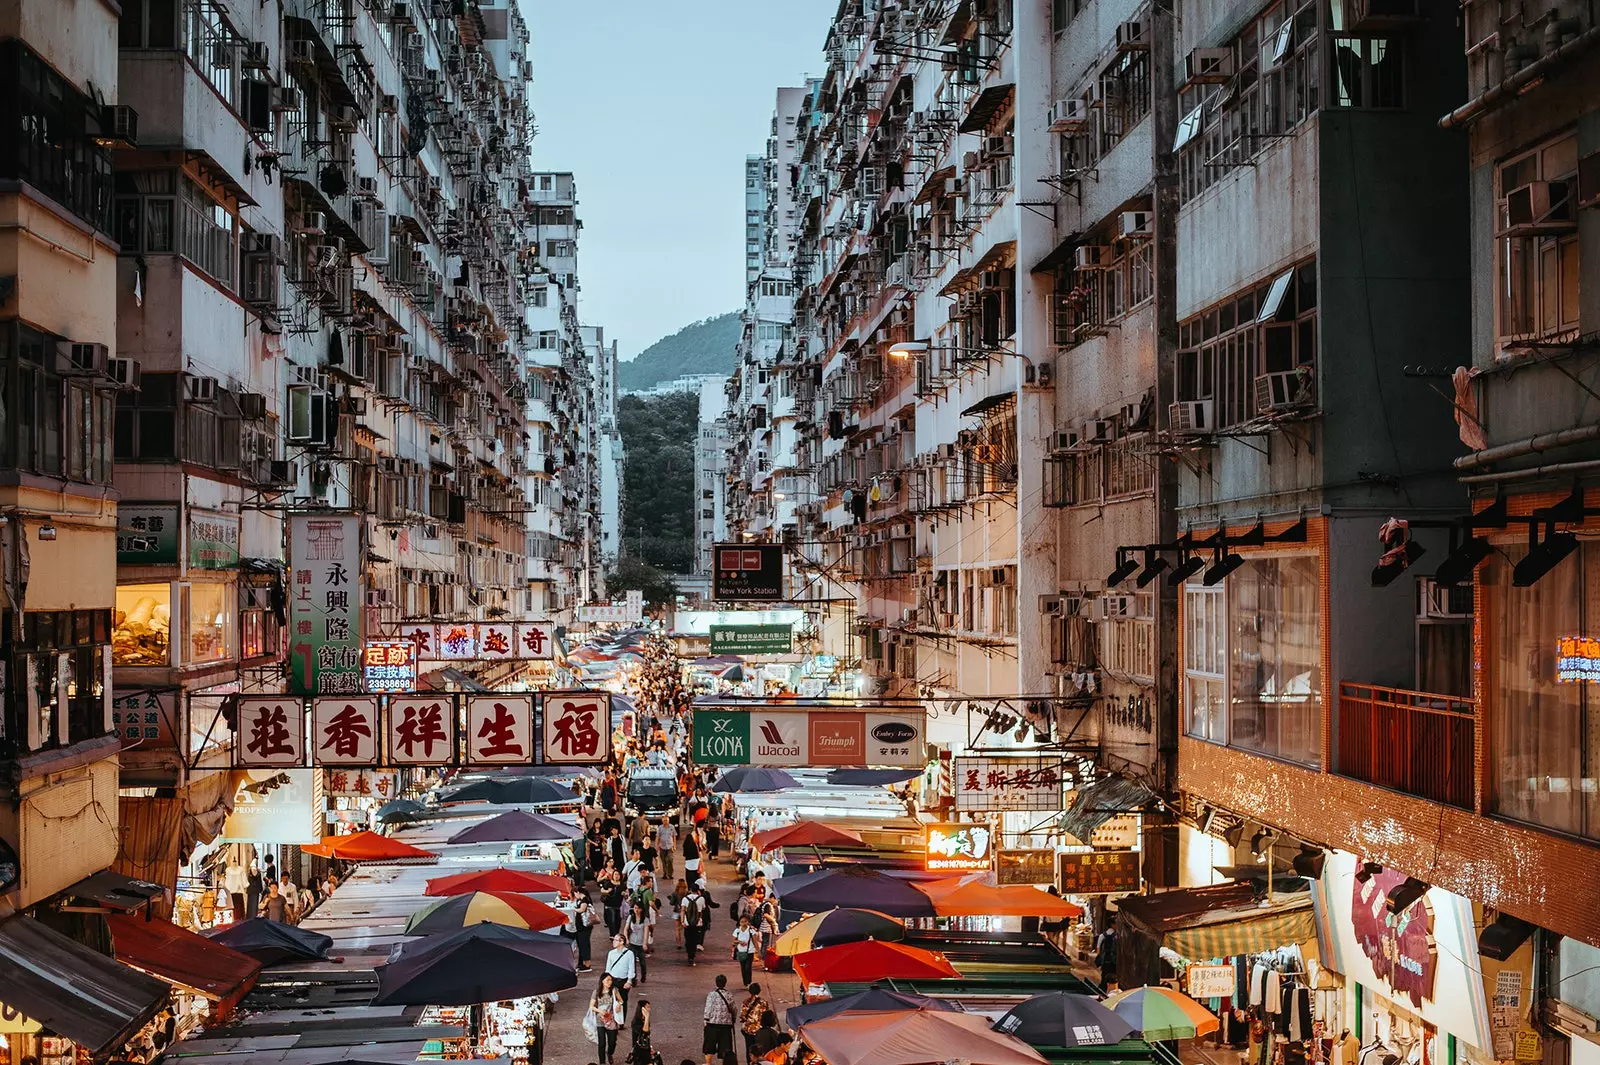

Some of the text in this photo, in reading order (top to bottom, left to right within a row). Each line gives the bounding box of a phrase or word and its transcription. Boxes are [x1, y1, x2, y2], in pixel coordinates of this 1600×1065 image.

[297, 569, 312, 634] 請上一樓
[367, 647, 409, 664] 足跡
[875, 729, 913, 738] Embry Form
[700, 736, 744, 757] LEONA
[819, 735, 855, 748] Triumph
[758, 745, 800, 756] Wacoal
[879, 747, 909, 756] 安莉芳
